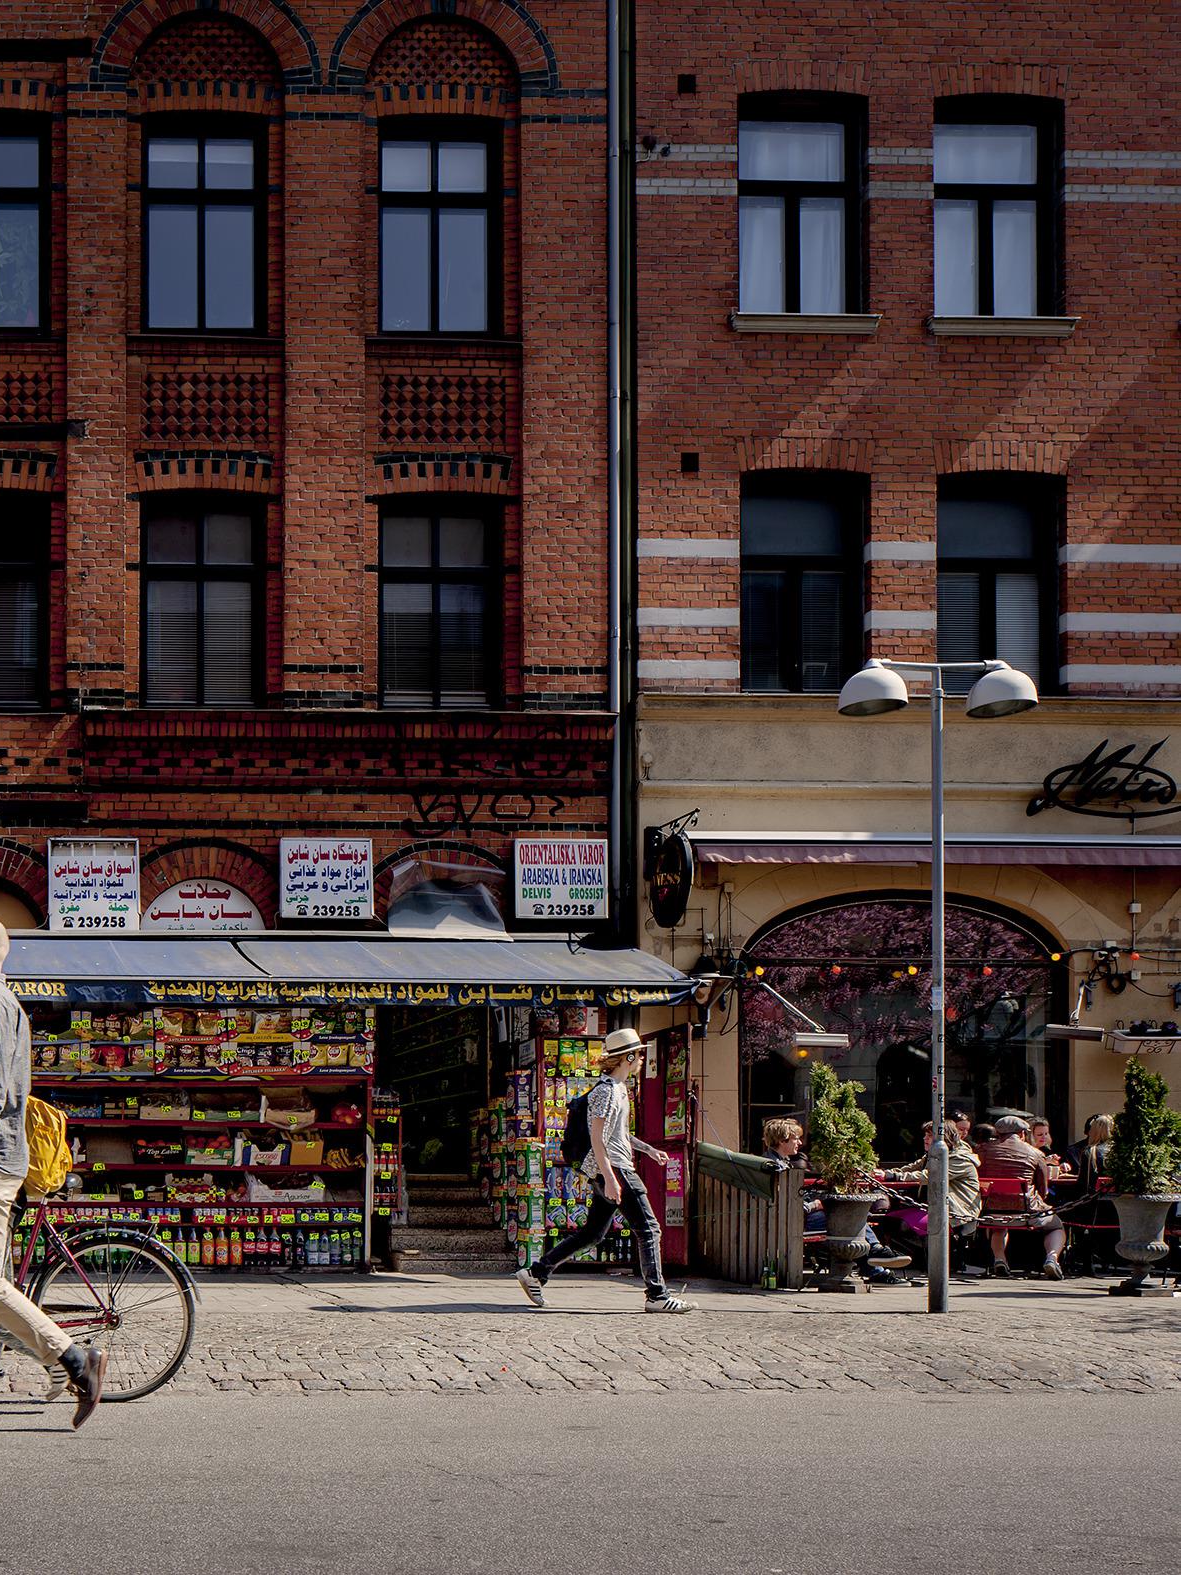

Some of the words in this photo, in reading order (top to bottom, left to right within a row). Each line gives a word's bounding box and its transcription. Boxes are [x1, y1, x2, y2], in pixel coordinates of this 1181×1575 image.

[287, 844, 309, 865] شاين
[312, 844, 330, 865] سان
[519, 844, 577, 865] ORIENTALISKA
[578, 844, 604, 865] VAROR
[54, 860, 80, 878] شاين
[82, 860, 104, 878] سان
[321, 865, 342, 880] مواد
[344, 865, 366, 880] انواع
[521, 868, 560, 885] ARABISKA
[561, 868, 567, 885] &
[569, 868, 603, 885] IRANSKA
[99, 878, 124, 890] للمواد
[178, 882, 231, 901] محلات
[321, 881, 328, 892] و
[93, 890, 99, 902] و
[522, 887, 552, 899] DELVIS
[568, 887, 604, 900] GROSSIST
[150, 903, 205, 921] شاين
[208, 903, 253, 921] سان
[312, 905, 361, 917] 239258
[547, 904, 595, 916] 239258
[77, 916, 126, 928] 239258
[396, 984, 450, 1005] للمواد
[458, 984, 533, 1005] شاين
[540, 985, 595, 1005] سان
[147, 1148, 160, 1156] Top
